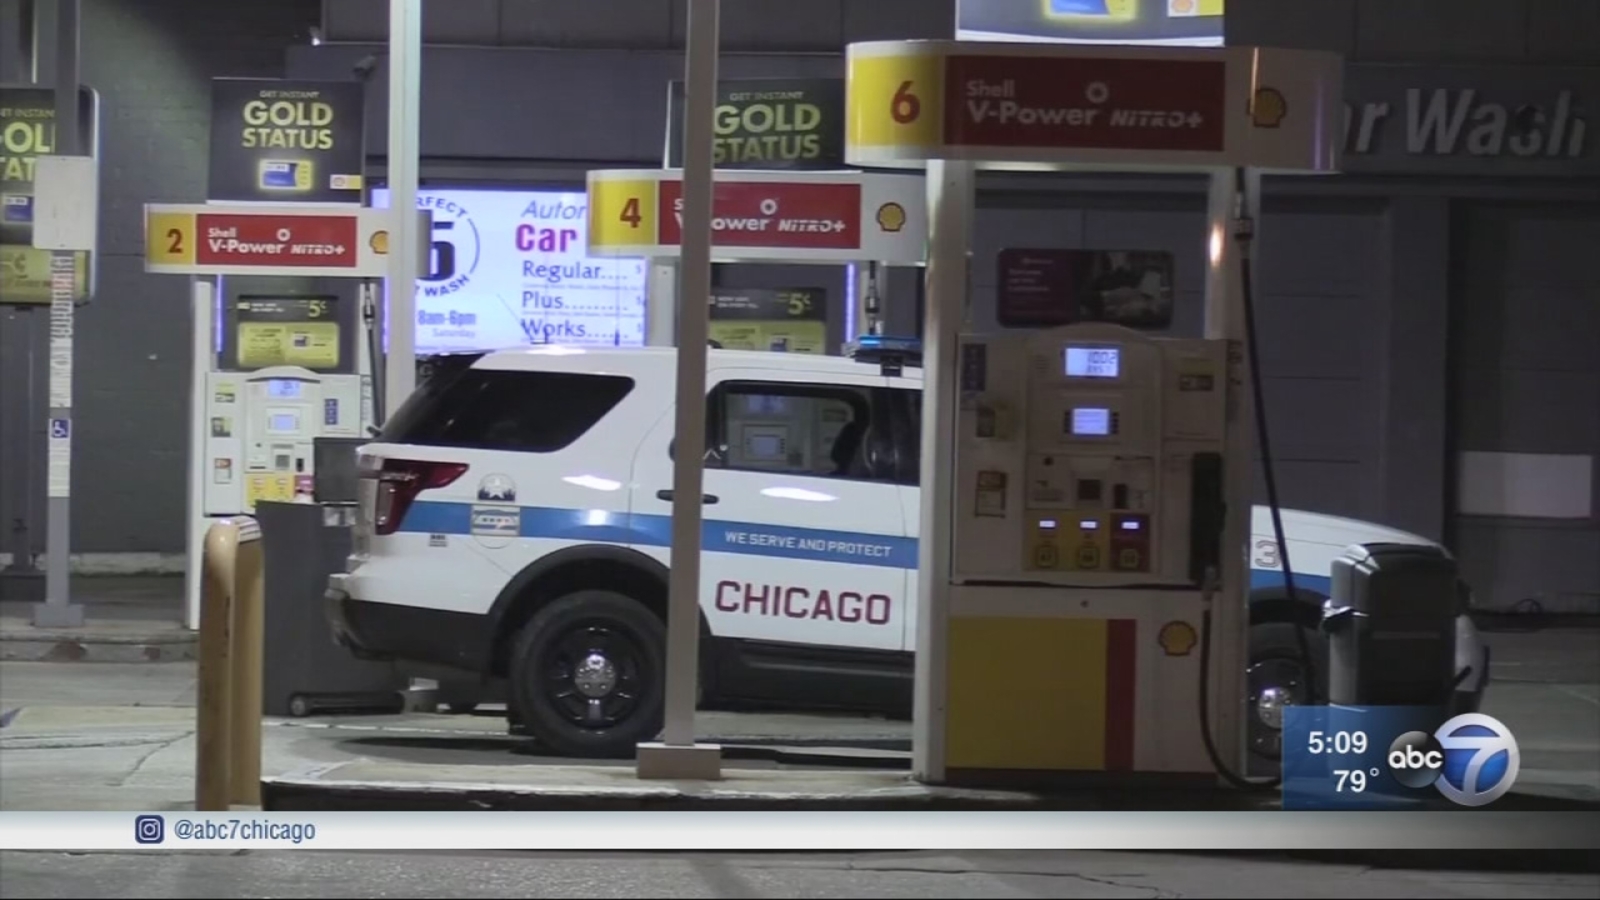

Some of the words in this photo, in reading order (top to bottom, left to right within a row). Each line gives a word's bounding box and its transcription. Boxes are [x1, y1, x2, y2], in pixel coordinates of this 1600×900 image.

[729, 92, 751, 101] GET
[966, 79, 1015, 98] Shell
[243, 101, 333, 126] GOLD
[890, 80, 920, 124] 6
[967, 101, 1098, 126] V-Power
[714, 104, 821, 135] GOLD
[1406, 88, 1586, 157] Wash
[242, 127, 333, 150] STATUS
[713, 134, 821, 163] STATUS
[619, 198, 642, 229] 4
[167, 228, 183, 253] 2
[208, 228, 237, 238] Shell
[515, 223, 577, 252] Car
[208, 239, 285, 255] V-Power
[425, 273, 470, 297] WASH
[725, 531, 748, 545] WE
[750, 533, 796, 549] SERVE
[799, 539, 826, 552] AND
[828, 543, 892, 558] PROTECT
[715, 580, 892, 626] CHICAGO
